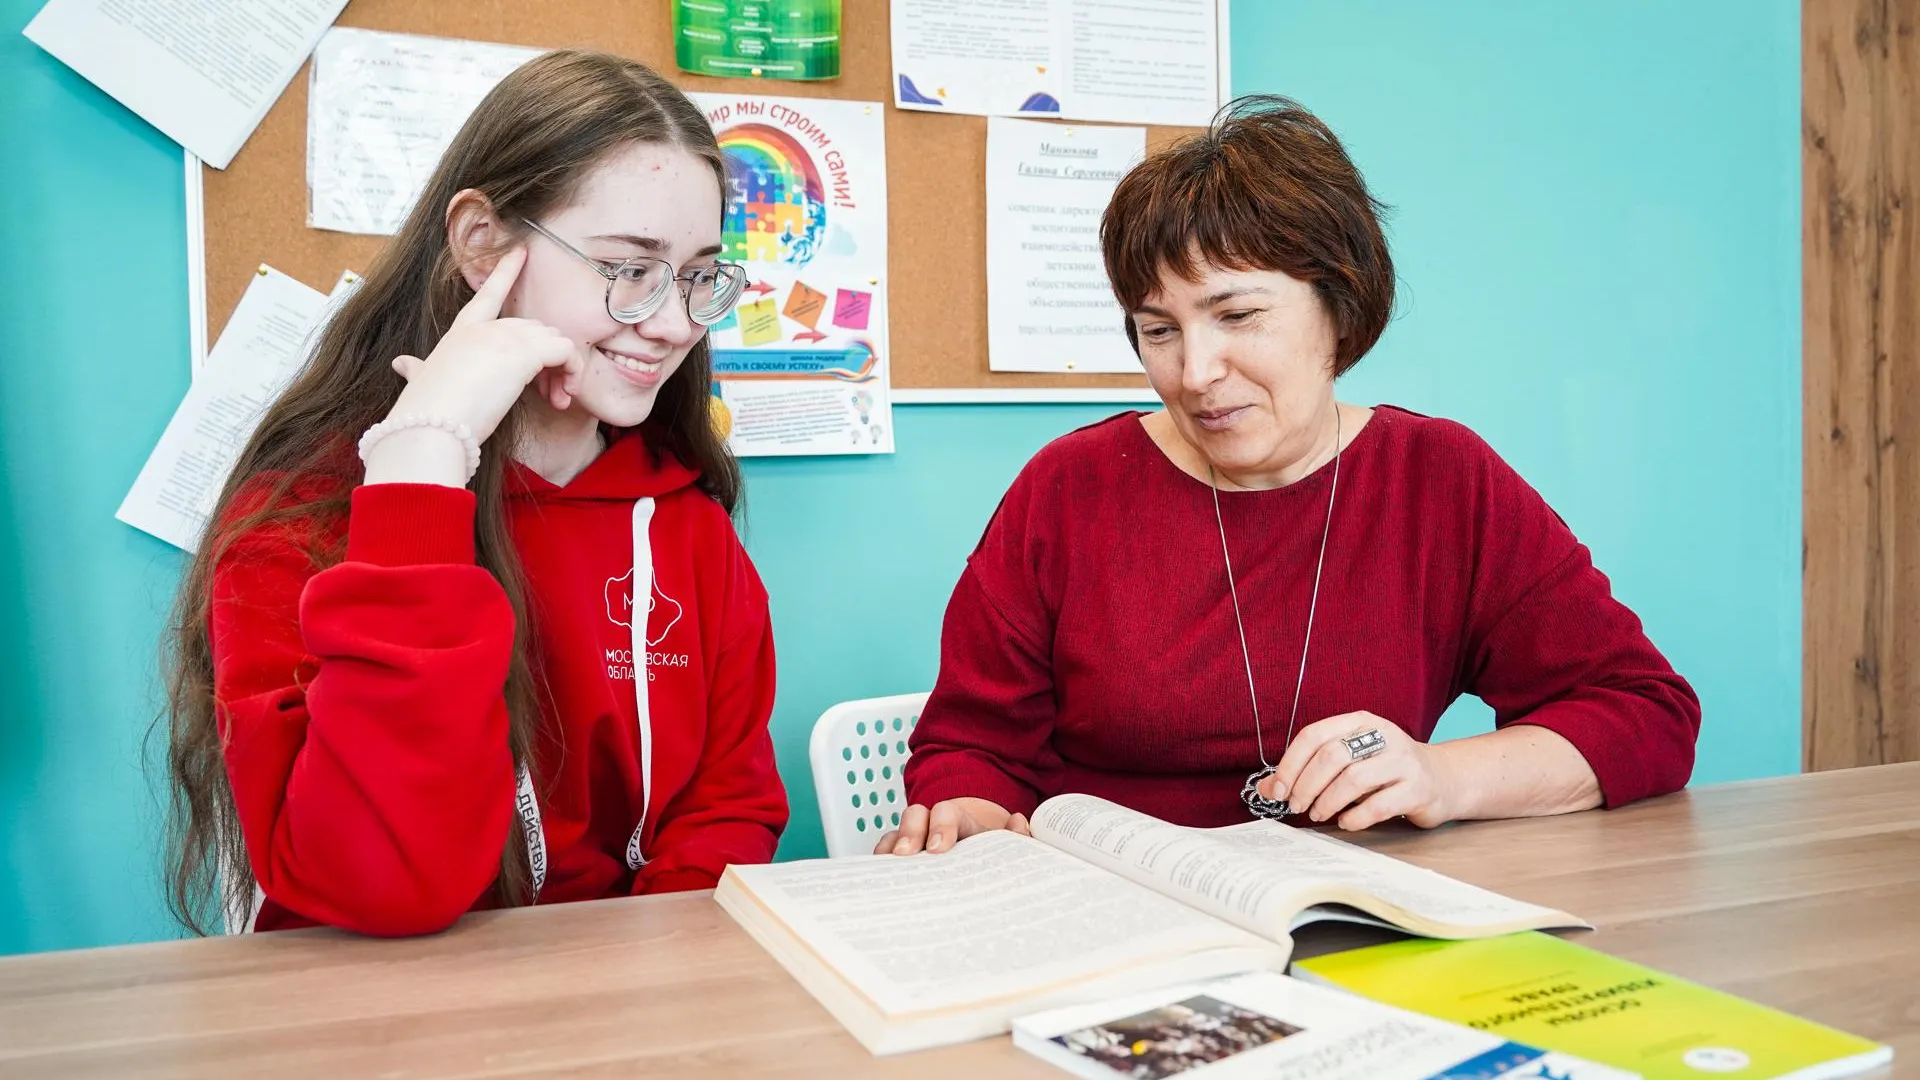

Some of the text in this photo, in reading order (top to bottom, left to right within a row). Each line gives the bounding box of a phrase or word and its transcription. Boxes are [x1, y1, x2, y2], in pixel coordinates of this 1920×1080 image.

[704, 101, 856, 210] ир мы строим сами!
[1017, 161, 1122, 181] Галина Сергеевна
[1007, 203, 1104, 217] советник директо
[1021, 241, 1103, 253] взаимодействи
[750, 361, 786, 371] СВОЕМУ
[605, 648, 689, 668] МОСВСКАЯ
[607, 665, 656, 682] ОБЛАЬ
